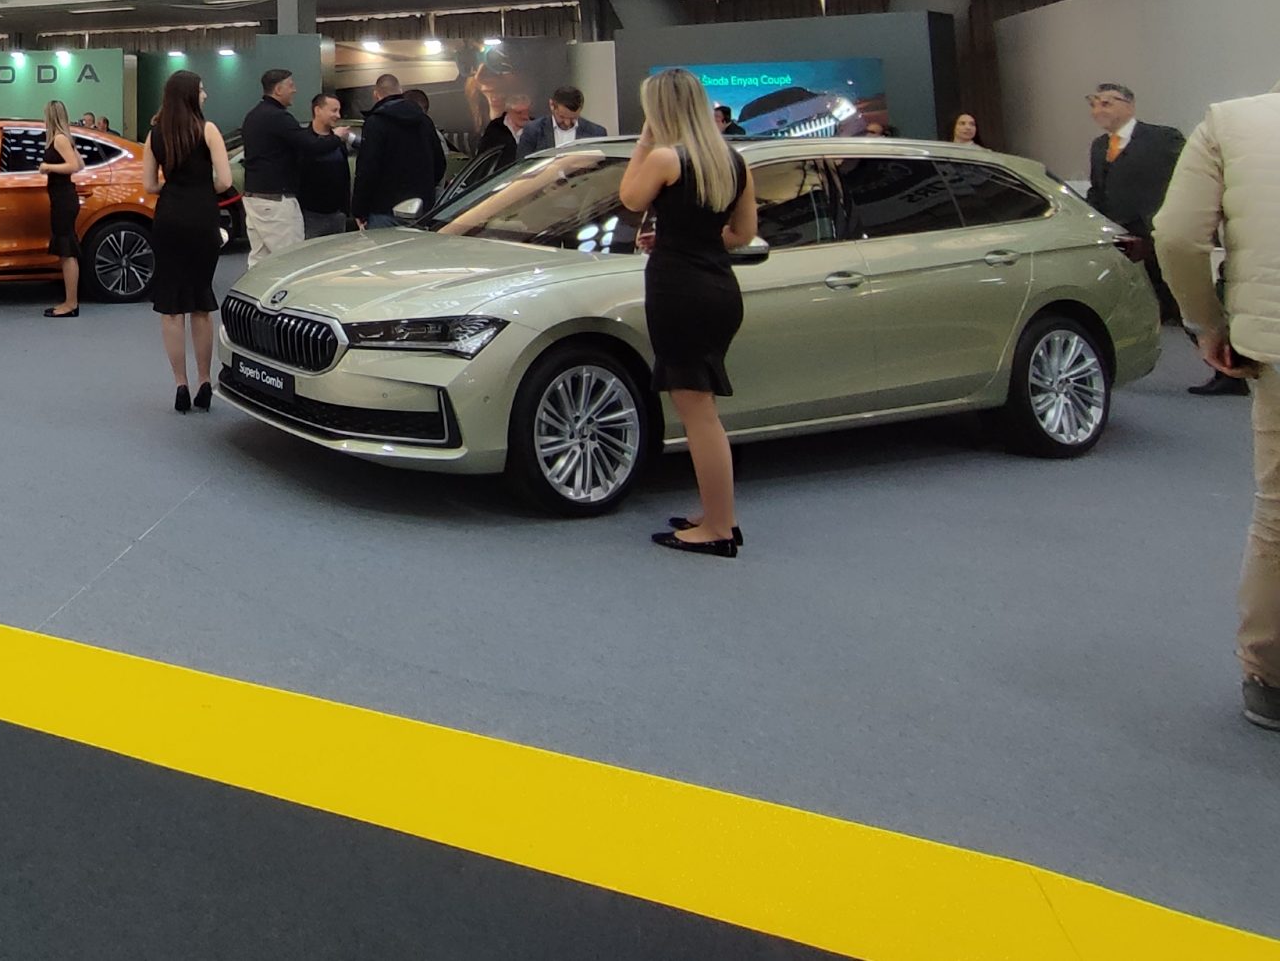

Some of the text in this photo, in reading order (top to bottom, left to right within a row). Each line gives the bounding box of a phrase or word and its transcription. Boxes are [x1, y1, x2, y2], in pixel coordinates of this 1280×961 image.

[730, 75, 759, 87] Enyaq
[760, 74, 792, 86] Coupé
[239, 361, 284, 390] Superb Combi
